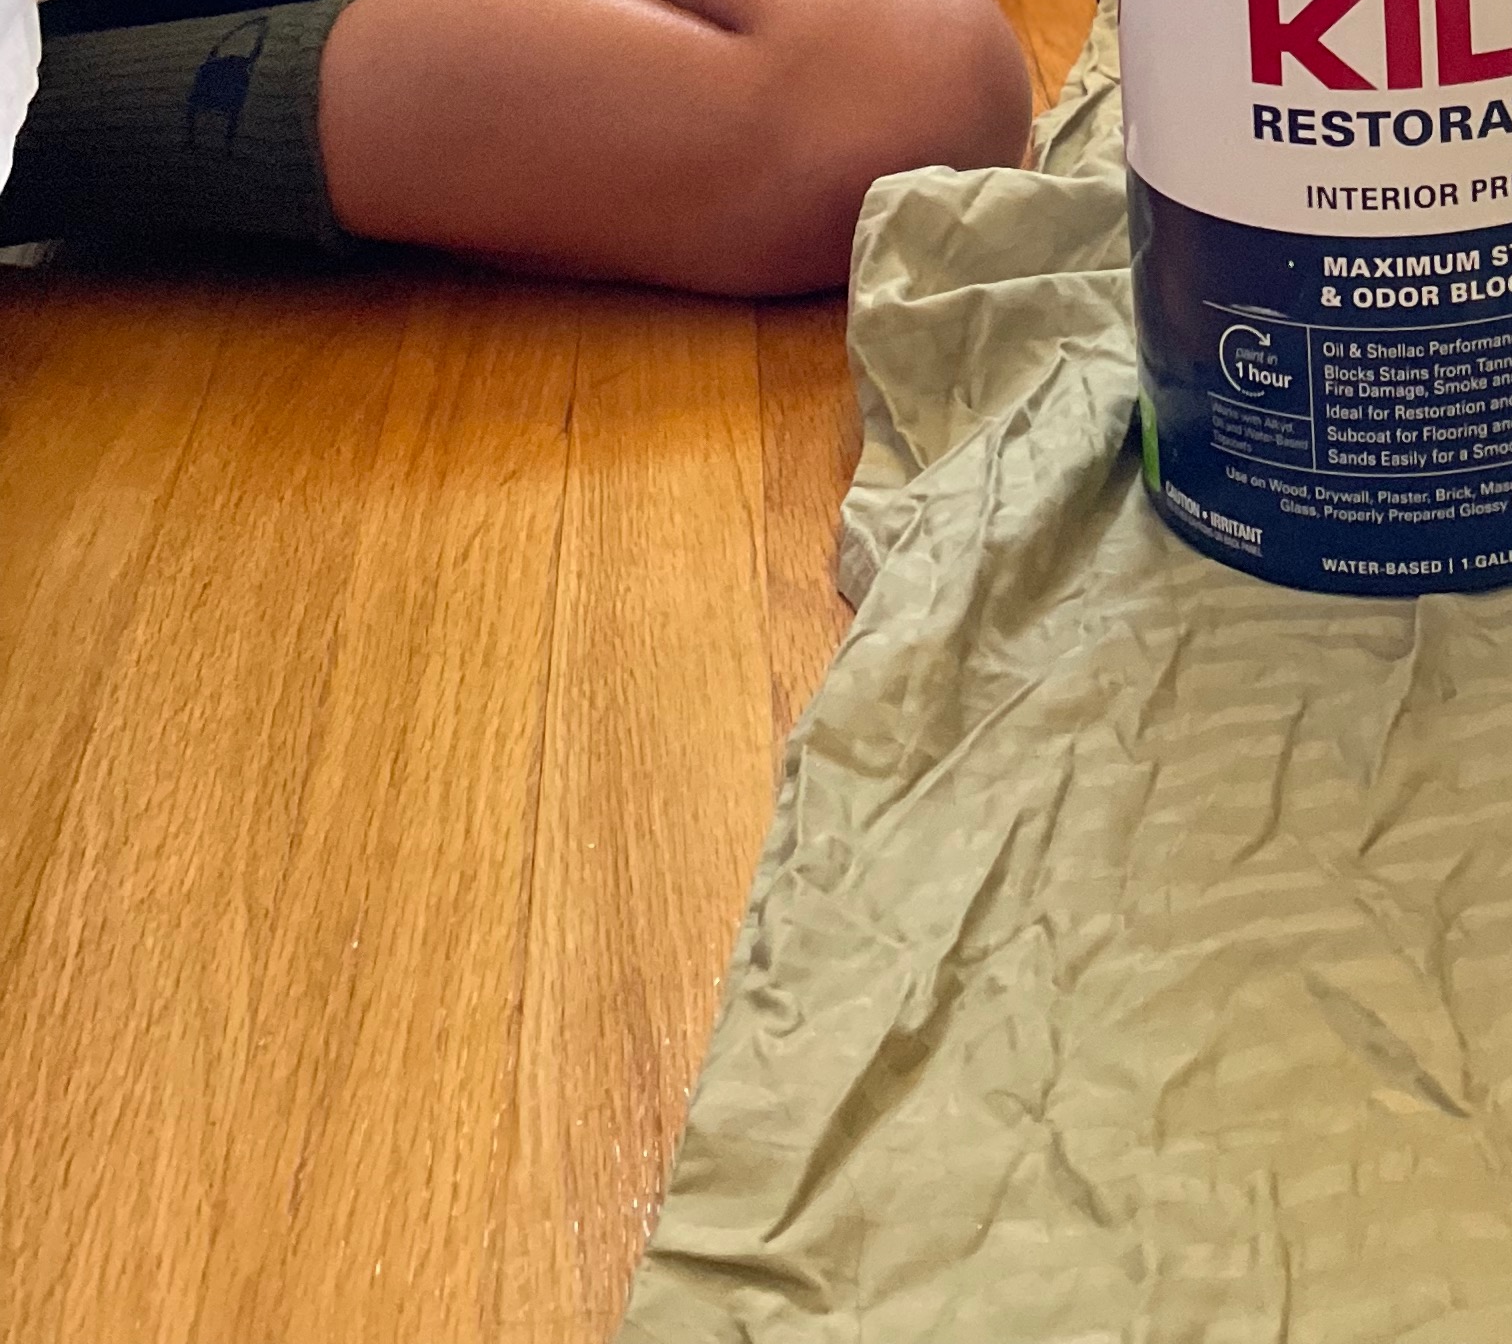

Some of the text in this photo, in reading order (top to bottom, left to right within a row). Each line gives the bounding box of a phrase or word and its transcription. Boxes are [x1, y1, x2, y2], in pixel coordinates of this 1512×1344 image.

[1306, 183, 1459, 211] INTERIOR
[1323, 250, 1480, 278] MAXIMUM
[1320, 286, 1342, 307] &
[1352, 286, 1440, 308] ODOR
[1323, 341, 1344, 357] Oil
[1349, 343, 1362, 358] &
[1367, 342, 1425, 358] Shellac
[1235, 362, 1292, 388] 1 hour
[1324, 365, 1374, 381] Blocks
[1379, 366, 1429, 381] Stains
[1434, 363, 1471, 378] from
[1325, 381, 1354, 397] Fire
[1358, 383, 1429, 400] Damage,
[1433, 377, 1488, 395] Smoke
[1326, 404, 1362, 420] Ideal
[1368, 405, 1390, 420] for
[1394, 399, 1485, 420] Restoration
[1327, 426, 1392, 444] Subcoat
[1396, 428, 1418, 443] for
[1423, 420, 1488, 441] Flooring
[1328, 449, 1376, 466] Sands
[1381, 451, 1427, 468] Easily
[1432, 449, 1454, 464] for
[1459, 449, 1468, 461] a
[1226, 465, 1247, 484] Use
[1250, 476, 1266, 489] on
[1268, 478, 1311, 499] Wood,
[1315, 486, 1374, 504] Drywall,
[1377, 490, 1430, 505] Plaster,
[1435, 487, 1476, 502] Brick,
[1165, 480, 1200, 519] CAUTION
[1210, 511, 1263, 545] IRRITANT
[1280, 498, 1320, 518] Glass,
[1324, 505, 1383, 524] Properly
[1388, 505, 1454, 524] Prepared
[1459, 498, 1507, 518] Glossy
[1321, 557, 1442, 576] WATER-BASED
[1461, 559, 1468, 570] 1
